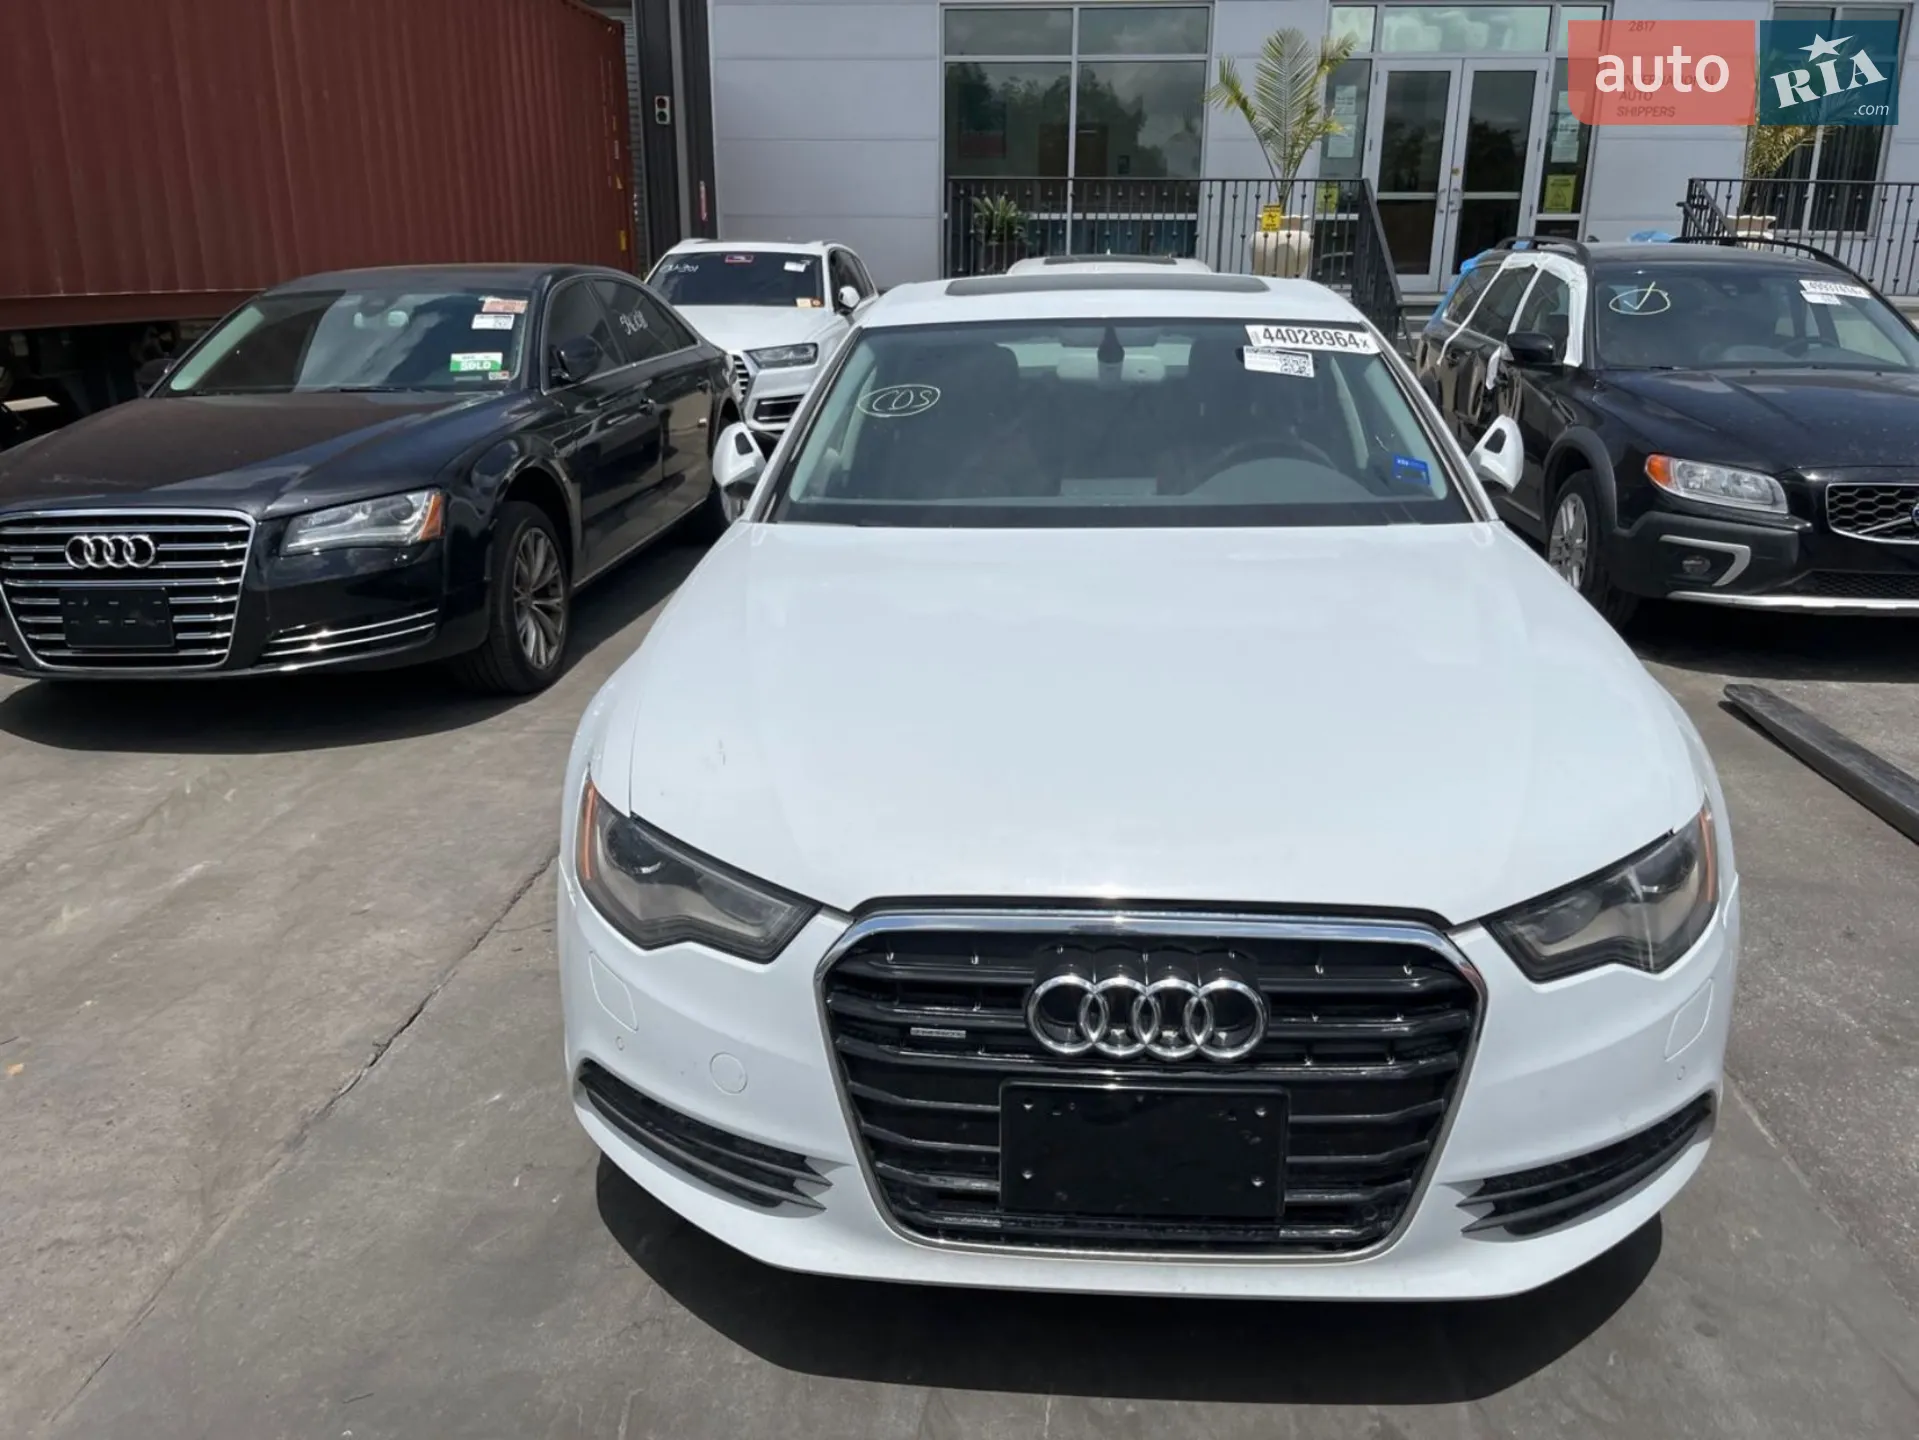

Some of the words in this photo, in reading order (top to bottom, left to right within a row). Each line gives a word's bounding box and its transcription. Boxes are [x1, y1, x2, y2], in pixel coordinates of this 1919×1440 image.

[1628, 20, 1656, 32] 2817
[1622, 74, 1715, 86] NERAIOAL
[1619, 89, 1653, 102] AUTO
[1616, 106, 1676, 118] SHIPPERS
